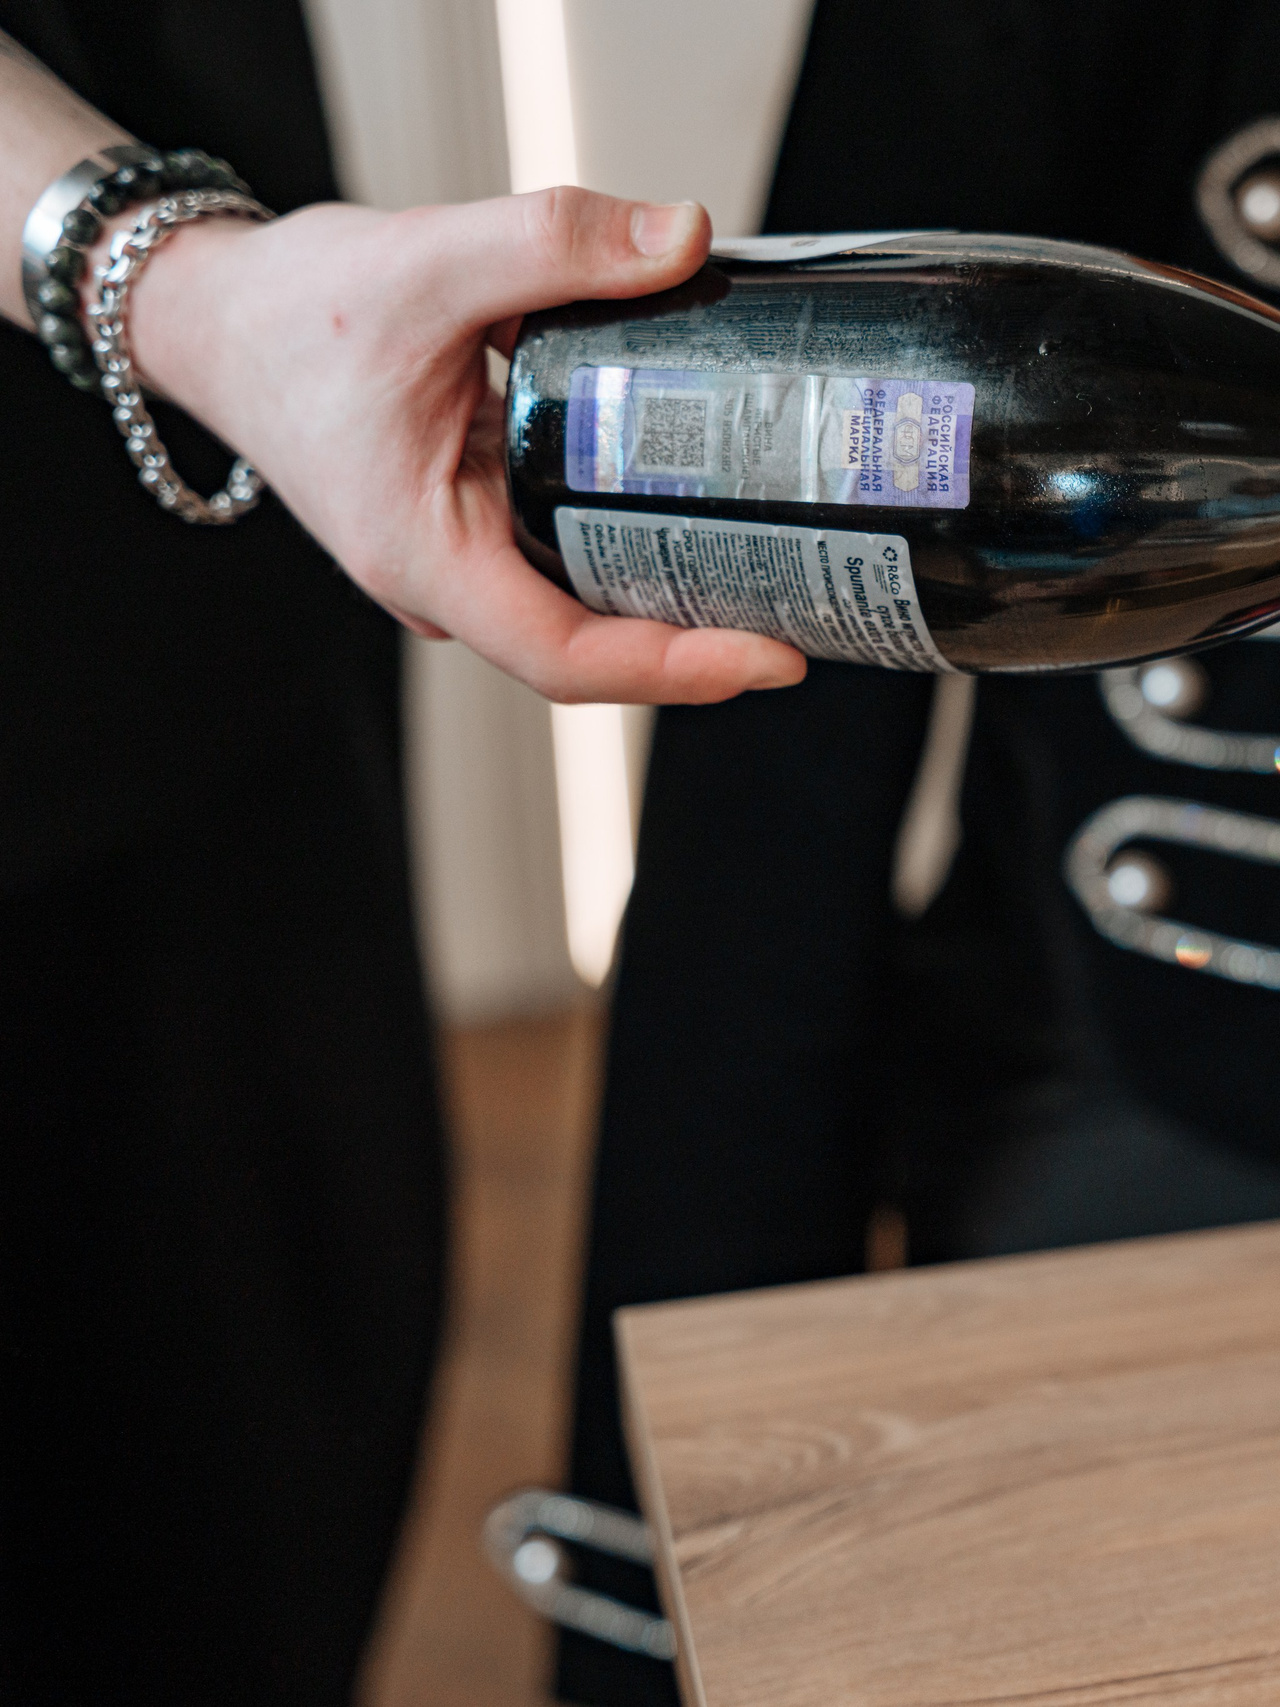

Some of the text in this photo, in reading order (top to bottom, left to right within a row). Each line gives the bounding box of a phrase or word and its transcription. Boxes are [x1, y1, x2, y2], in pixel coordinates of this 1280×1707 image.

[752, 408, 762, 466] ИГРИСТЫЕ
[764, 422, 773, 452] ВИНА
[849, 415, 860, 463] МАРКА
[860, 389, 873, 491] СПЕЦИАЛЬНАЯ
[872, 390, 886, 491] ФЕДЕРАЛЬНАЯ
[926, 395, 942, 491] ФЕДЕРАЦИЯ
[939, 395, 954, 491] РОССИЙСКАЯ
[844, 557, 873, 617] Spumante
[886, 565, 901, 594] R&Co
[893, 599, 911, 621] Вино
